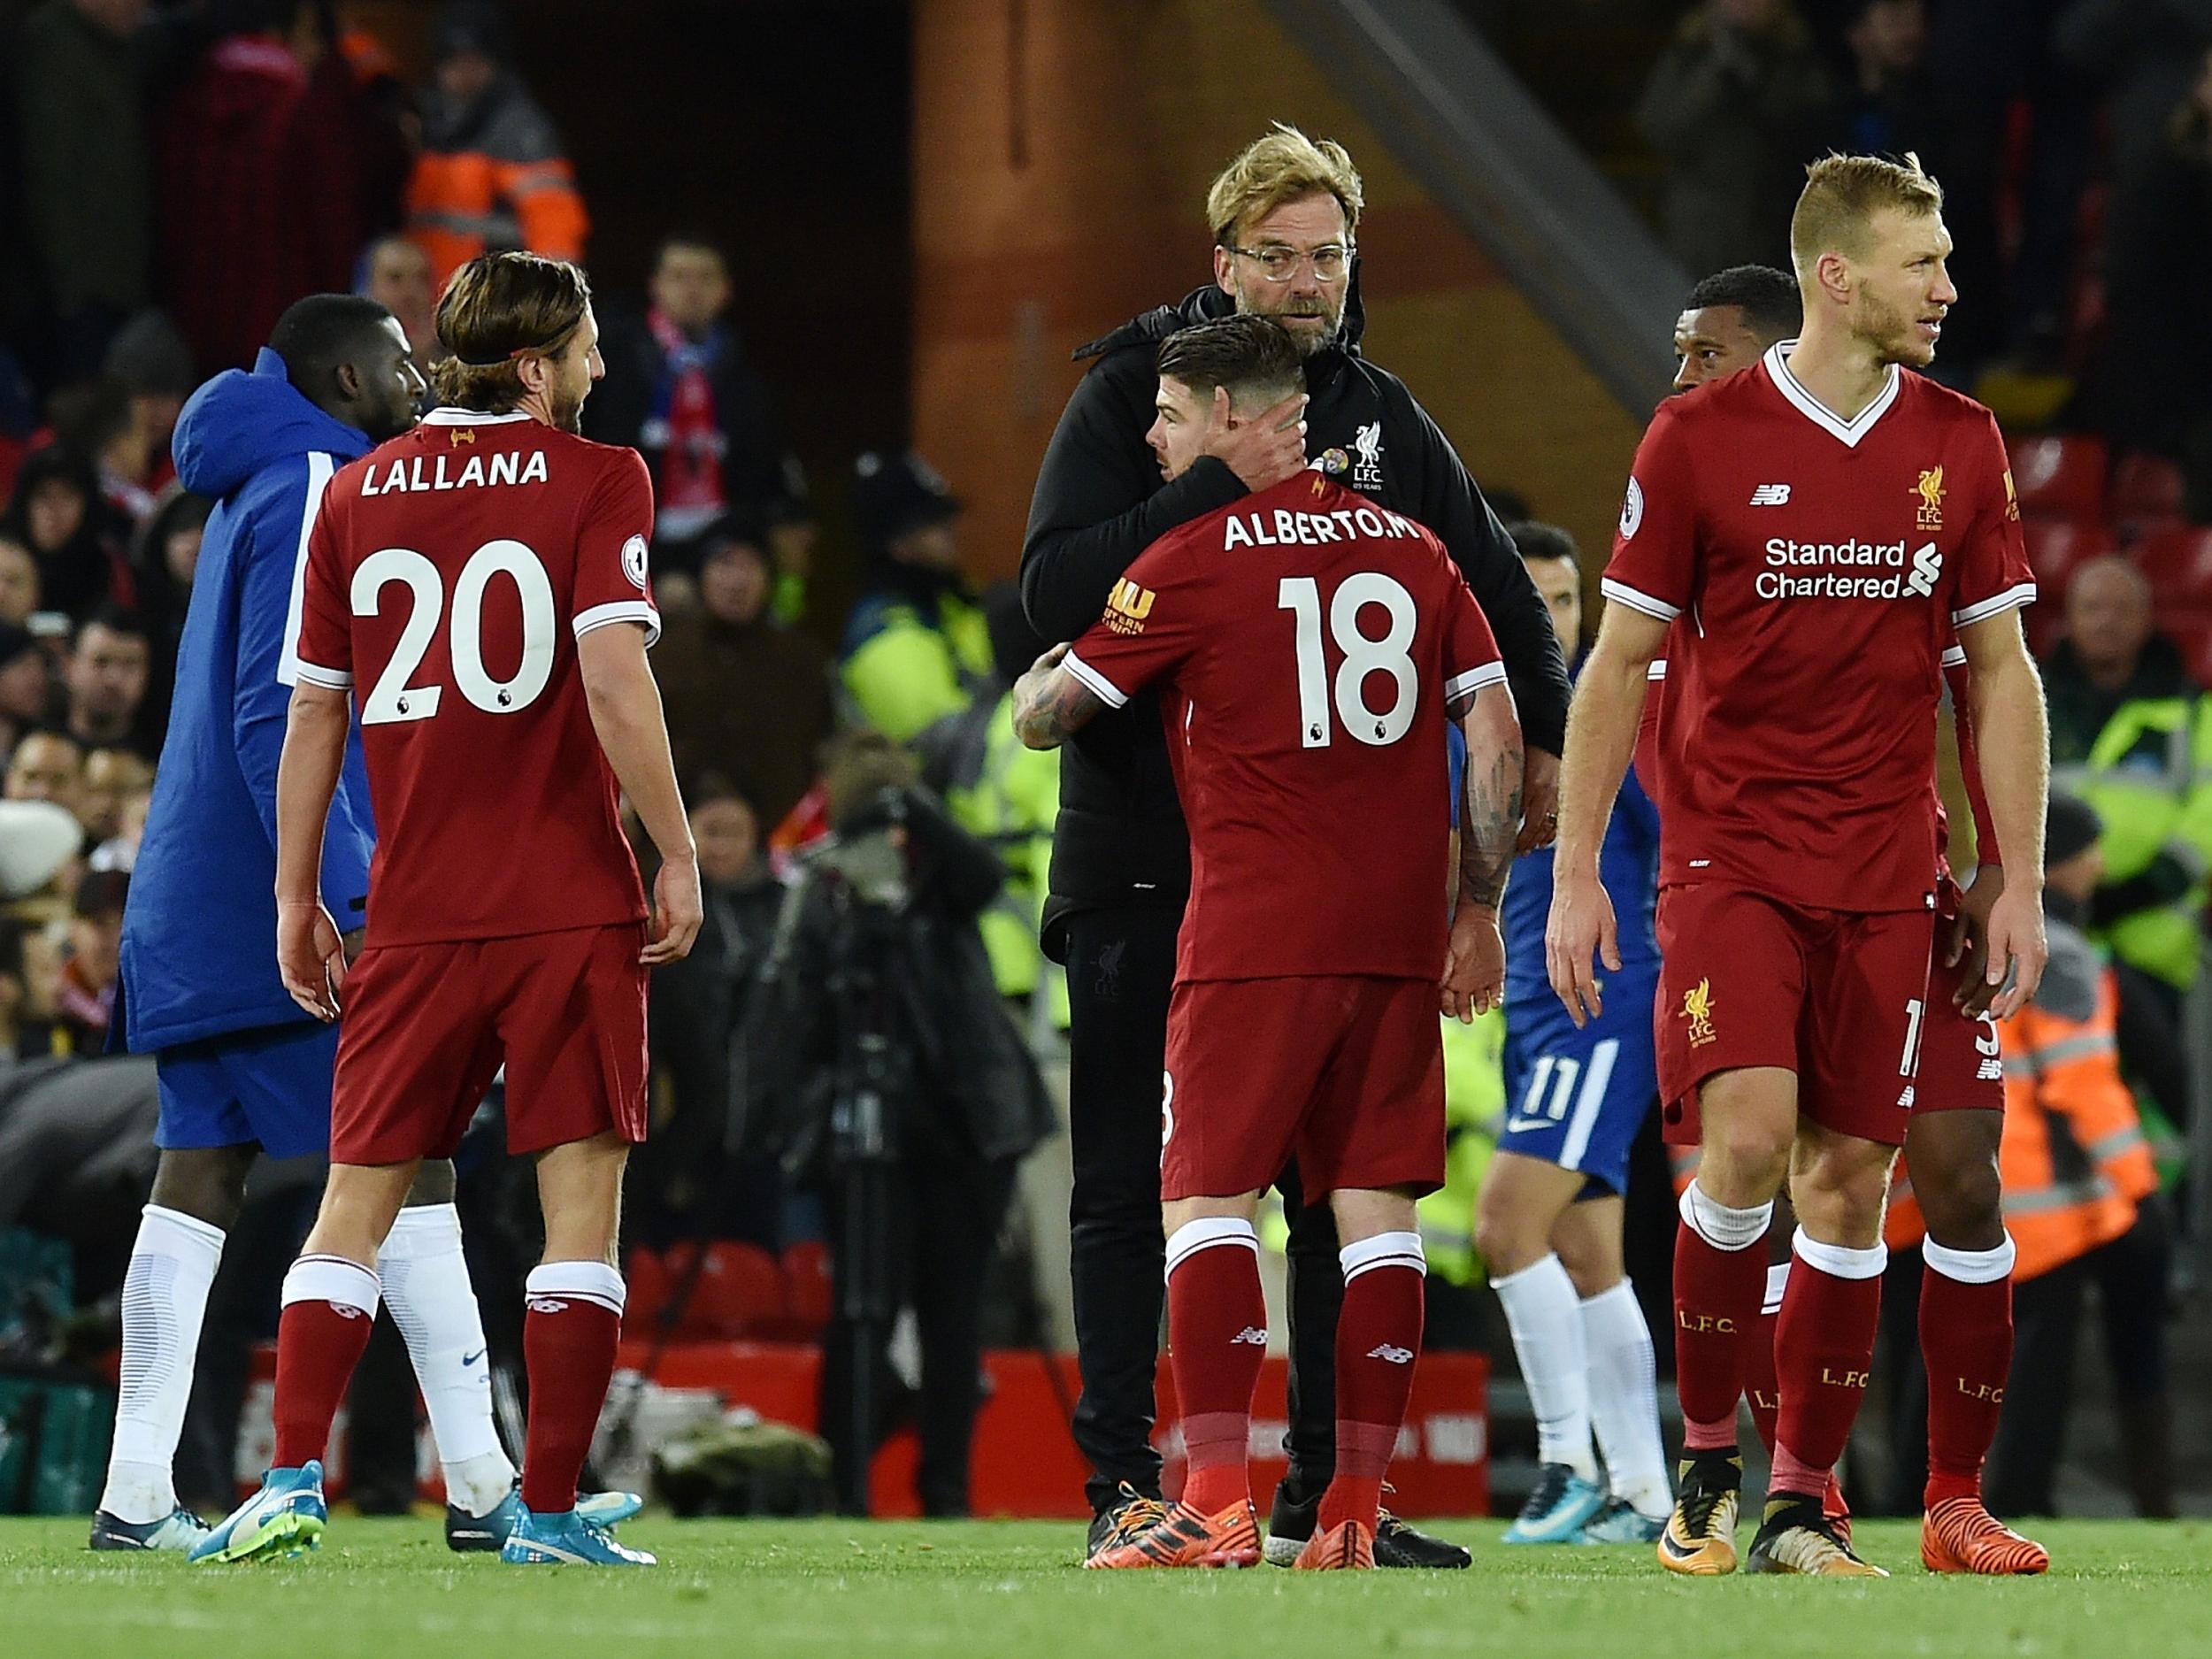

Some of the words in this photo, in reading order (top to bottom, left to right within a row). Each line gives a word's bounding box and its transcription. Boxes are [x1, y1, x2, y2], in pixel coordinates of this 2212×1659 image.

[361, 450, 549, 496] LALLANA
[1225, 508, 1420, 551] ALBERTO.M
[1765, 538, 1905, 566] Standard
[1755, 572, 1901, 599] Chartered
[350, 539, 556, 726] 20
[1278, 572, 1418, 749] 18
[1523, 1056, 1580, 1121] 11
